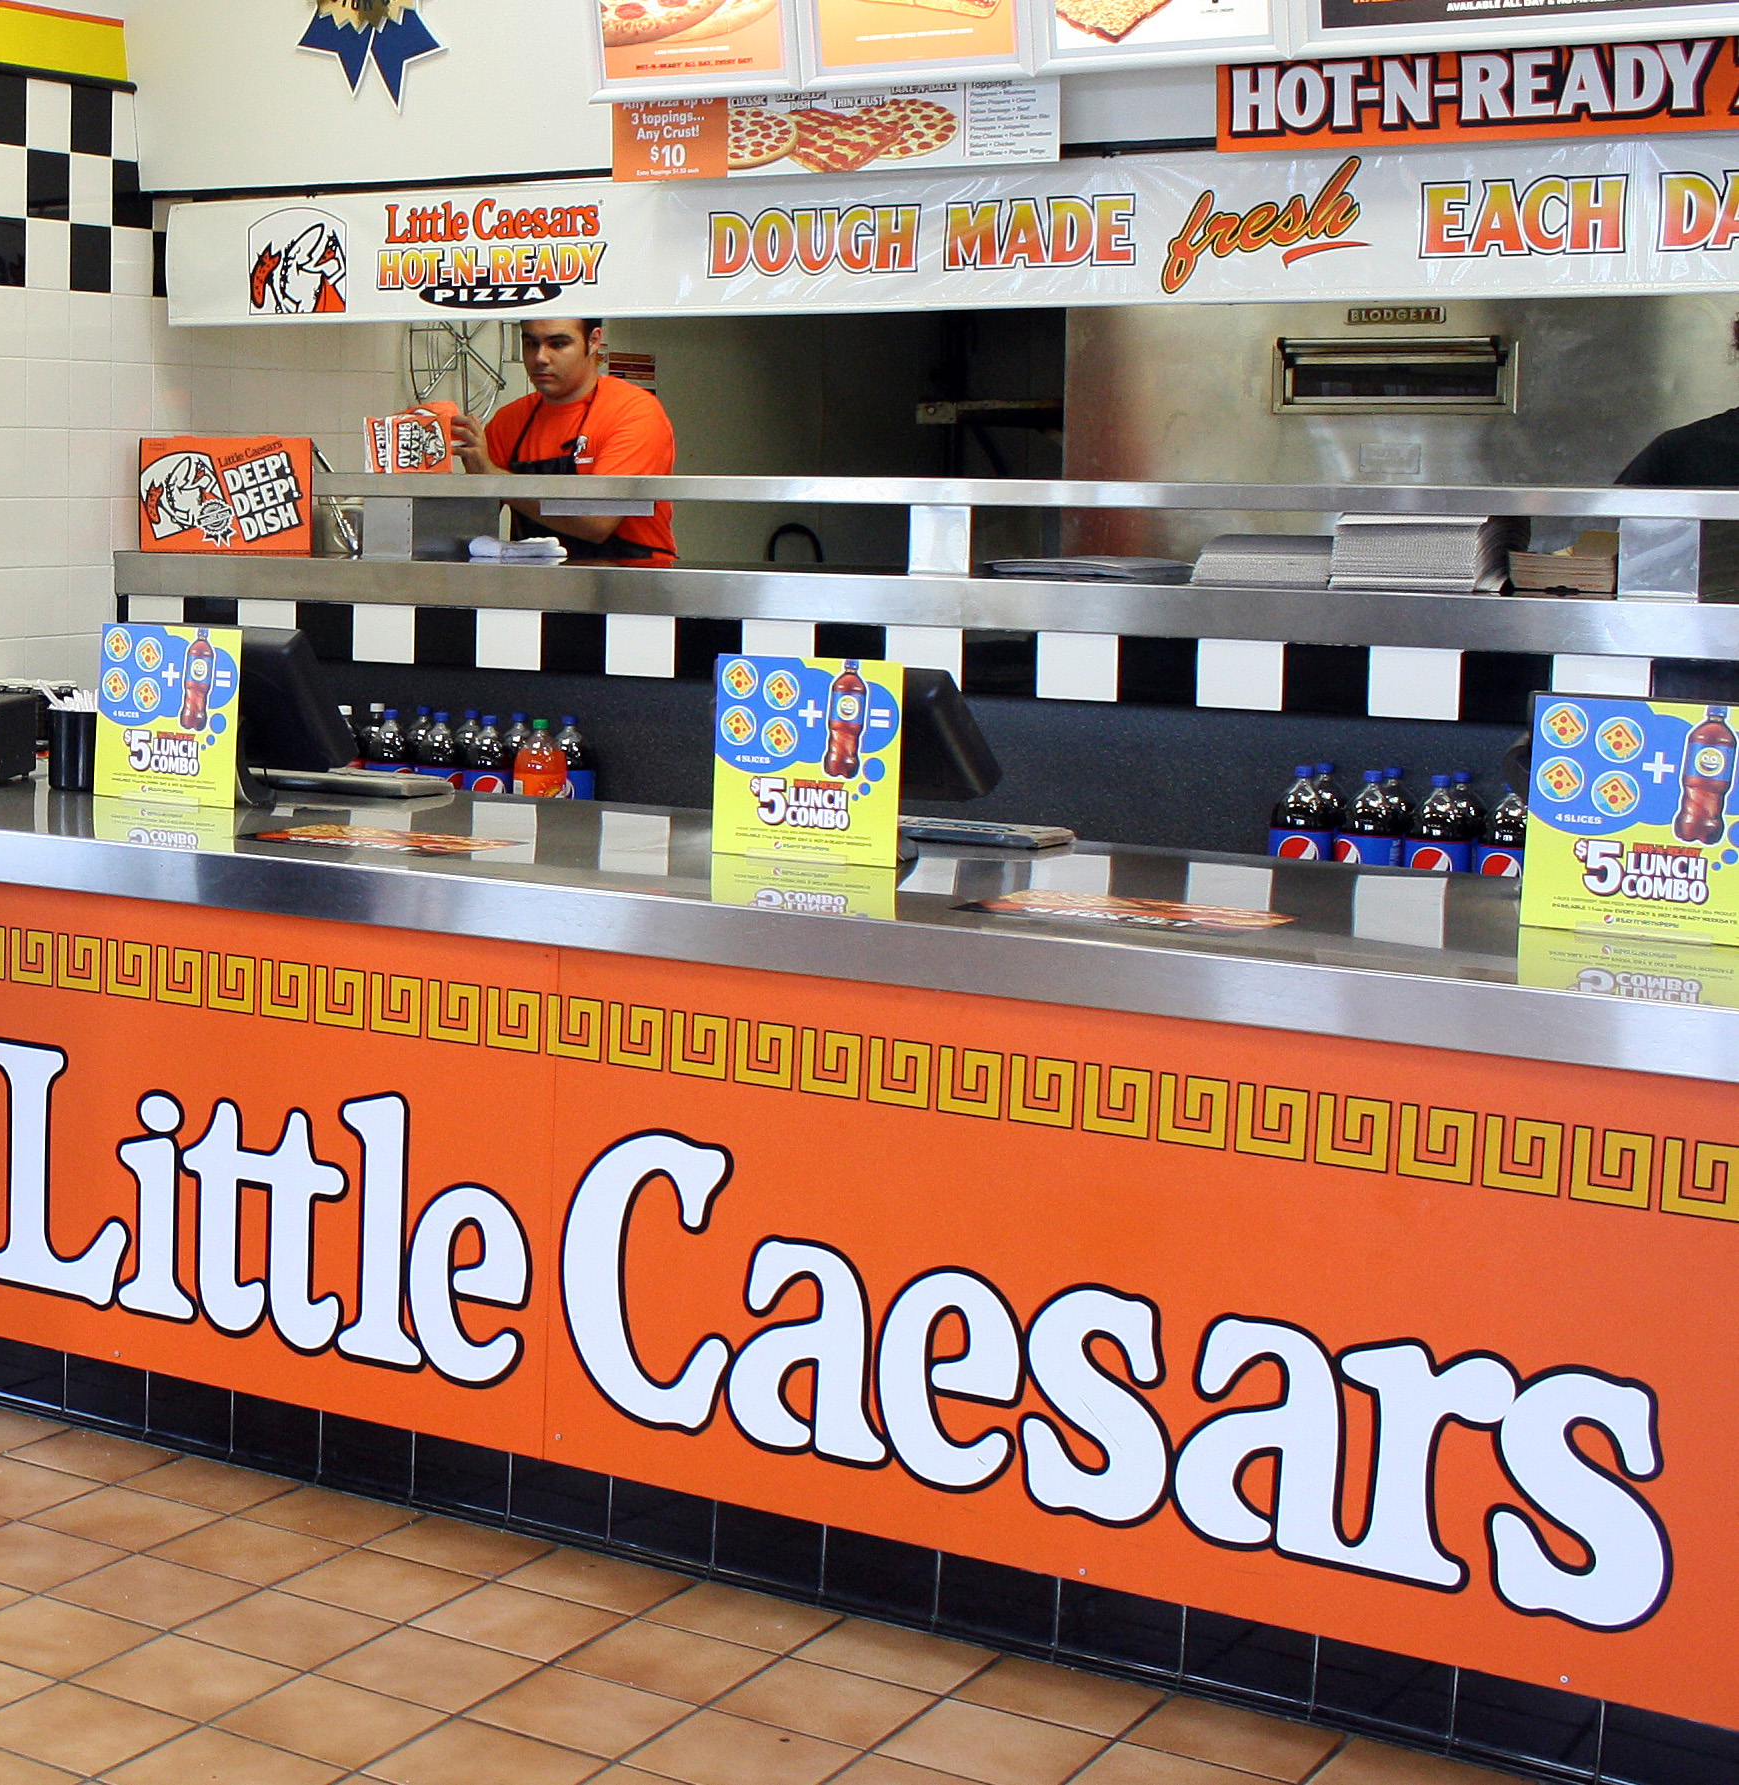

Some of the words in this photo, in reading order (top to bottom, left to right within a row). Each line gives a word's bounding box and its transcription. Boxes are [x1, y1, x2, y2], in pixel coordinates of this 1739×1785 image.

[1446, 1, 1500, 12] AVAILABLE
[1230, 38, 1725, 138] HOT-N-READY
[730, 95, 768, 108] CLASSIC
[832, 97, 854, 109] THIN
[855, 95, 885, 108] CRUST
[631, 113, 639, 125] 3
[636, 127, 660, 142] Any
[663, 124, 700, 139] Crust!
[650, 143, 686, 167] $10
[384, 202, 472, 245] Little
[474, 198, 600, 240] Caesars
[707, 202, 921, 278] DOUGH
[943, 193, 1136, 272] MADE
[1162, 155, 1361, 294] fresh
[1419, 172, 1630, 259] EACH
[376, 241, 607, 290] HOT-N-READY
[433, 285, 547, 303] PIZZA
[1349, 308, 1438, 323] BLODGETT
[217, 450, 244, 467] Little
[243, 441, 283, 459] Caesars
[398, 422, 411, 468] BREAD
[222, 451, 292, 494] DEEP!
[230, 475, 303, 518] DEEP!
[239, 501, 302, 542] DISH
[152, 738, 199, 759] LUNCH
[742, 755, 771, 765] SLICES
[150, 755, 200, 777] COMBO
[788, 786, 849, 811] LUNCH
[785, 806, 850, 831] COMBO
[1564, 814, 1603, 825] SLICES
[1626, 851, 1709, 881] LUNCH
[1621, 874, 1710, 906] COMBO
[558, 1126, 1674, 1634] Caesars
